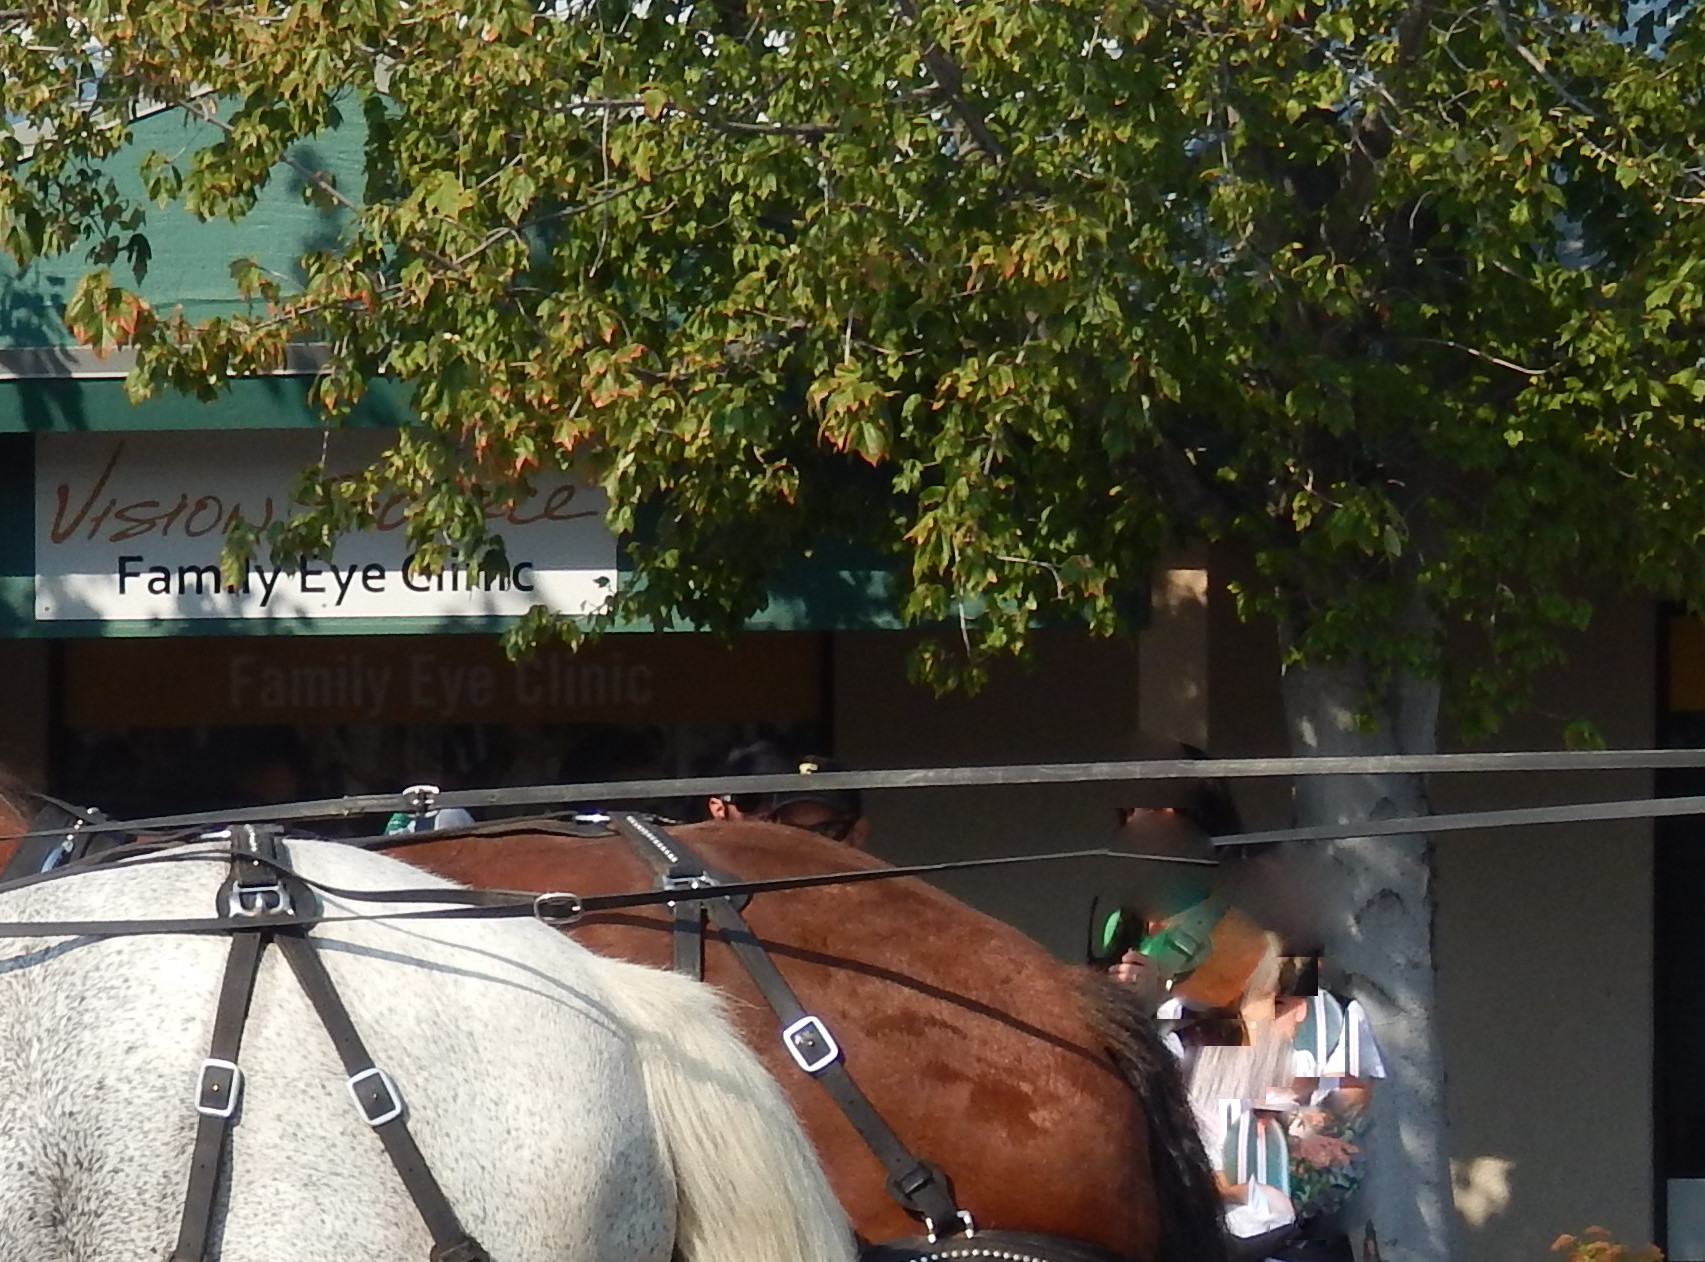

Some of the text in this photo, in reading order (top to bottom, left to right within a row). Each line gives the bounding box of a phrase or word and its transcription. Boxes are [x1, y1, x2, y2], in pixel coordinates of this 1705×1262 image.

[118, 547, 534, 608] Famly Eye Clic
[228, 650, 655, 717] Family Eye Clinic
